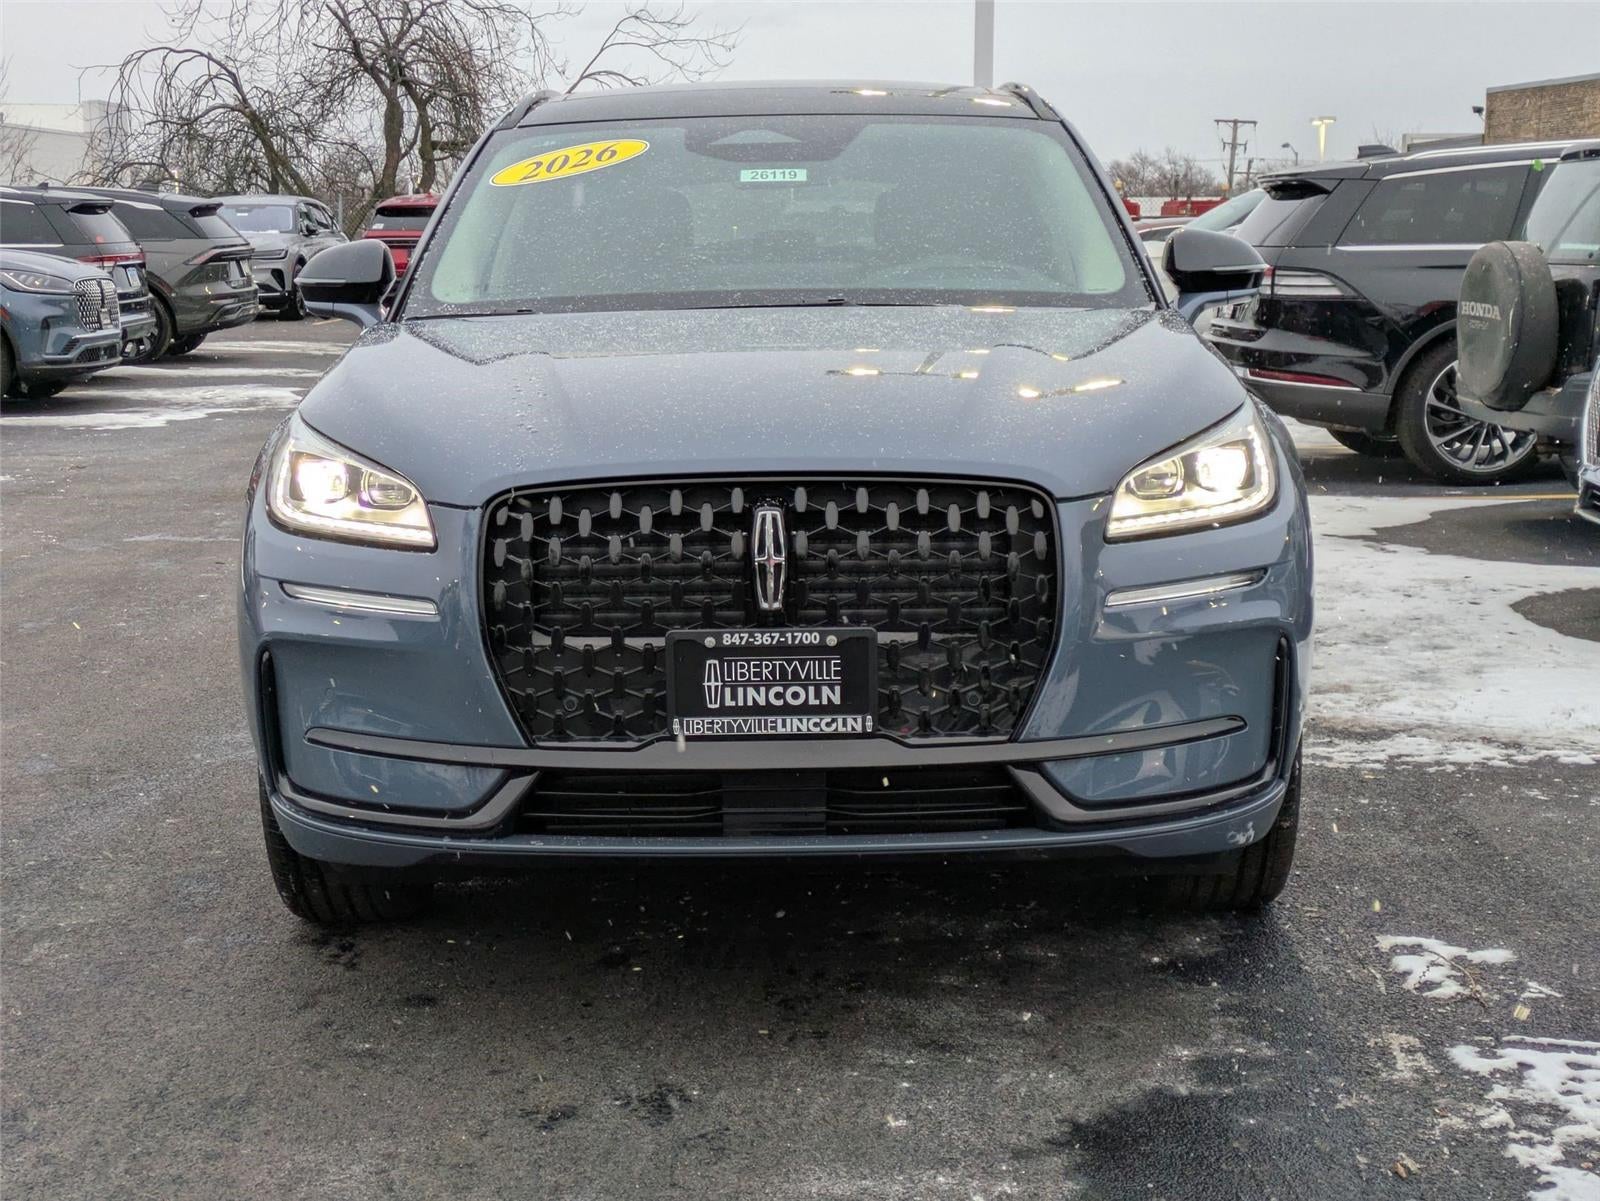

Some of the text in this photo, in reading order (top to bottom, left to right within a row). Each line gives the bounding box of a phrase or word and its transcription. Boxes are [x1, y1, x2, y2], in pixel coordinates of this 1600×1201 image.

[519, 142, 621, 181] 2026
[750, 170, 797, 180] 26119
[1461, 301, 1501, 320] HONDA
[722, 632, 820, 645] 847-367-1700
[724, 659, 842, 681] LIBERTYVILLE
[724, 685, 841, 707] LINCOLN
